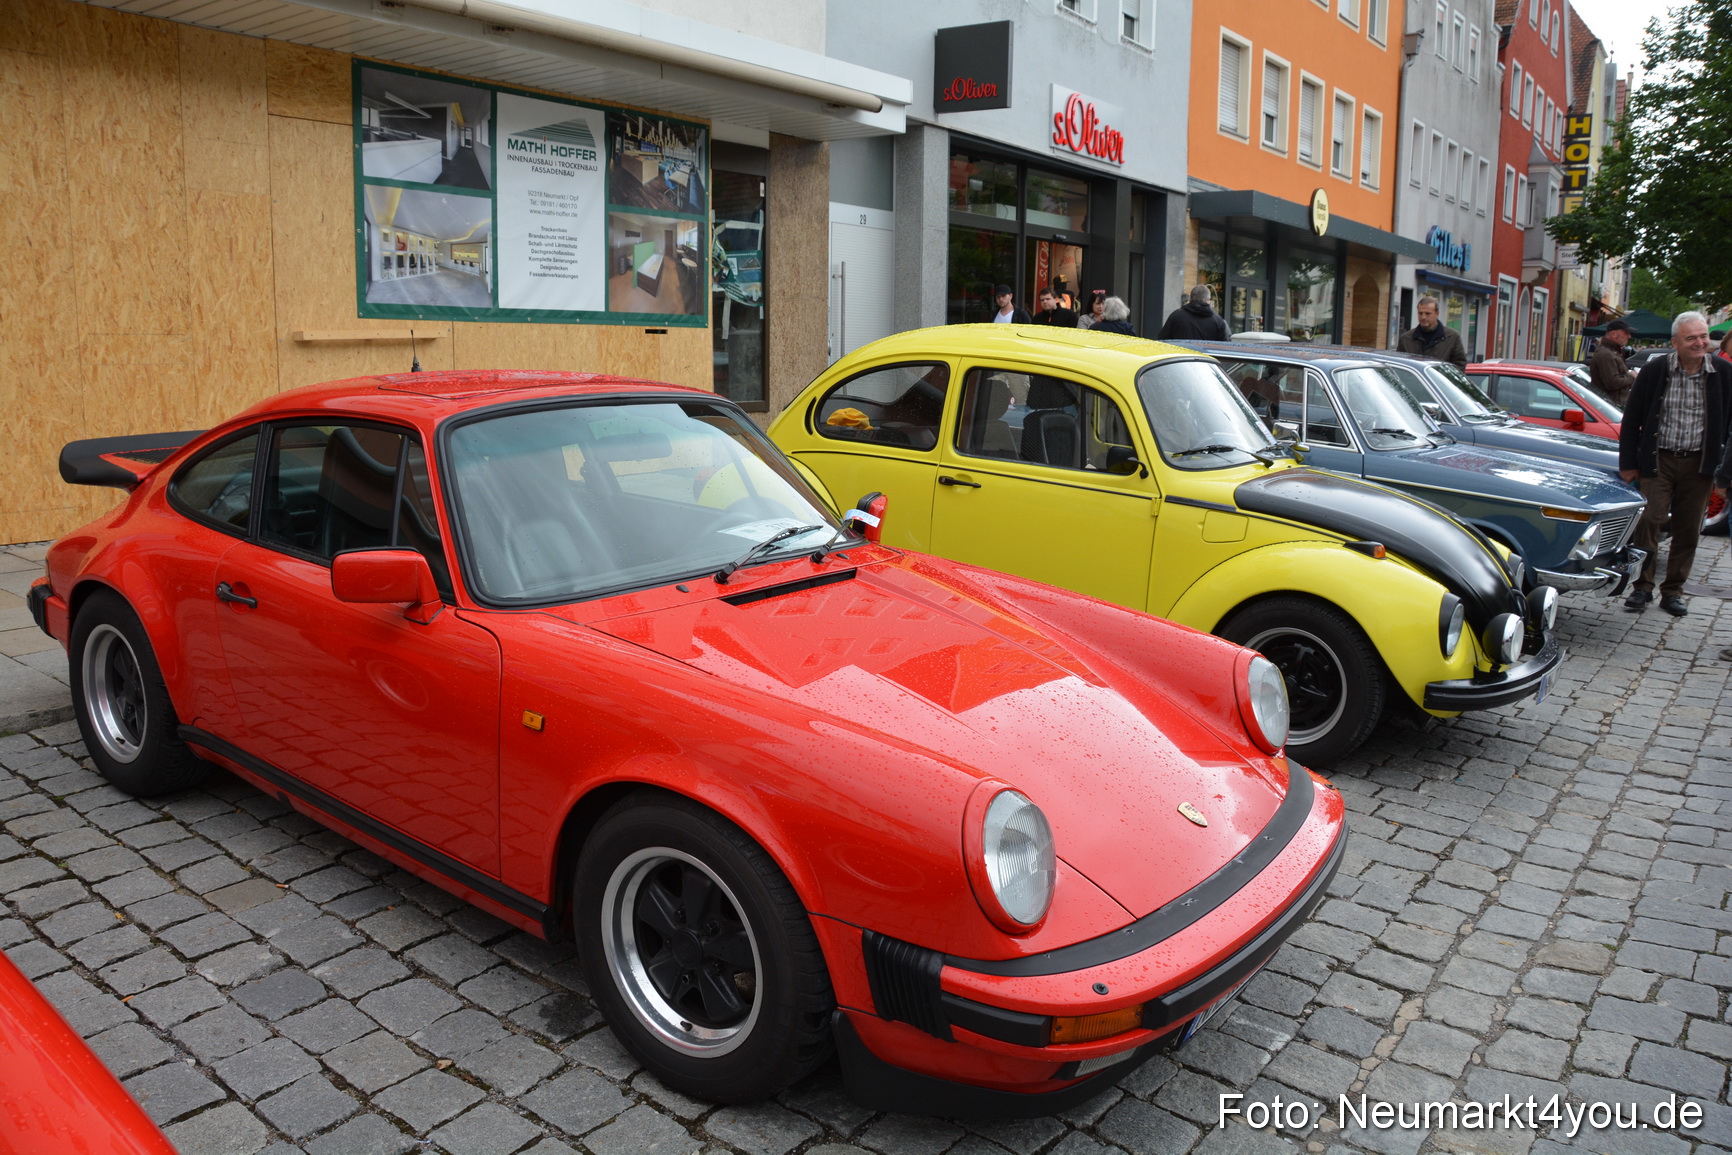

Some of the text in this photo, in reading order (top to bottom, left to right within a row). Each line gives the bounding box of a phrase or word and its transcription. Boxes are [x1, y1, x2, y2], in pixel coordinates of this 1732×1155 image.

[943, 77, 998, 101] s.Oliver
[1053, 92, 1126, 164] s.Oliver
[507, 137, 597, 161] MATHI HOFFER
[507, 154, 553, 166] INNENAUSBAU
[558, 161, 598, 172] TROCKENBAU
[531, 165, 575, 177] FASSADENBAU
[1564, 116, 1591, 240] HOTE
[859, 214, 867, 225] 29
